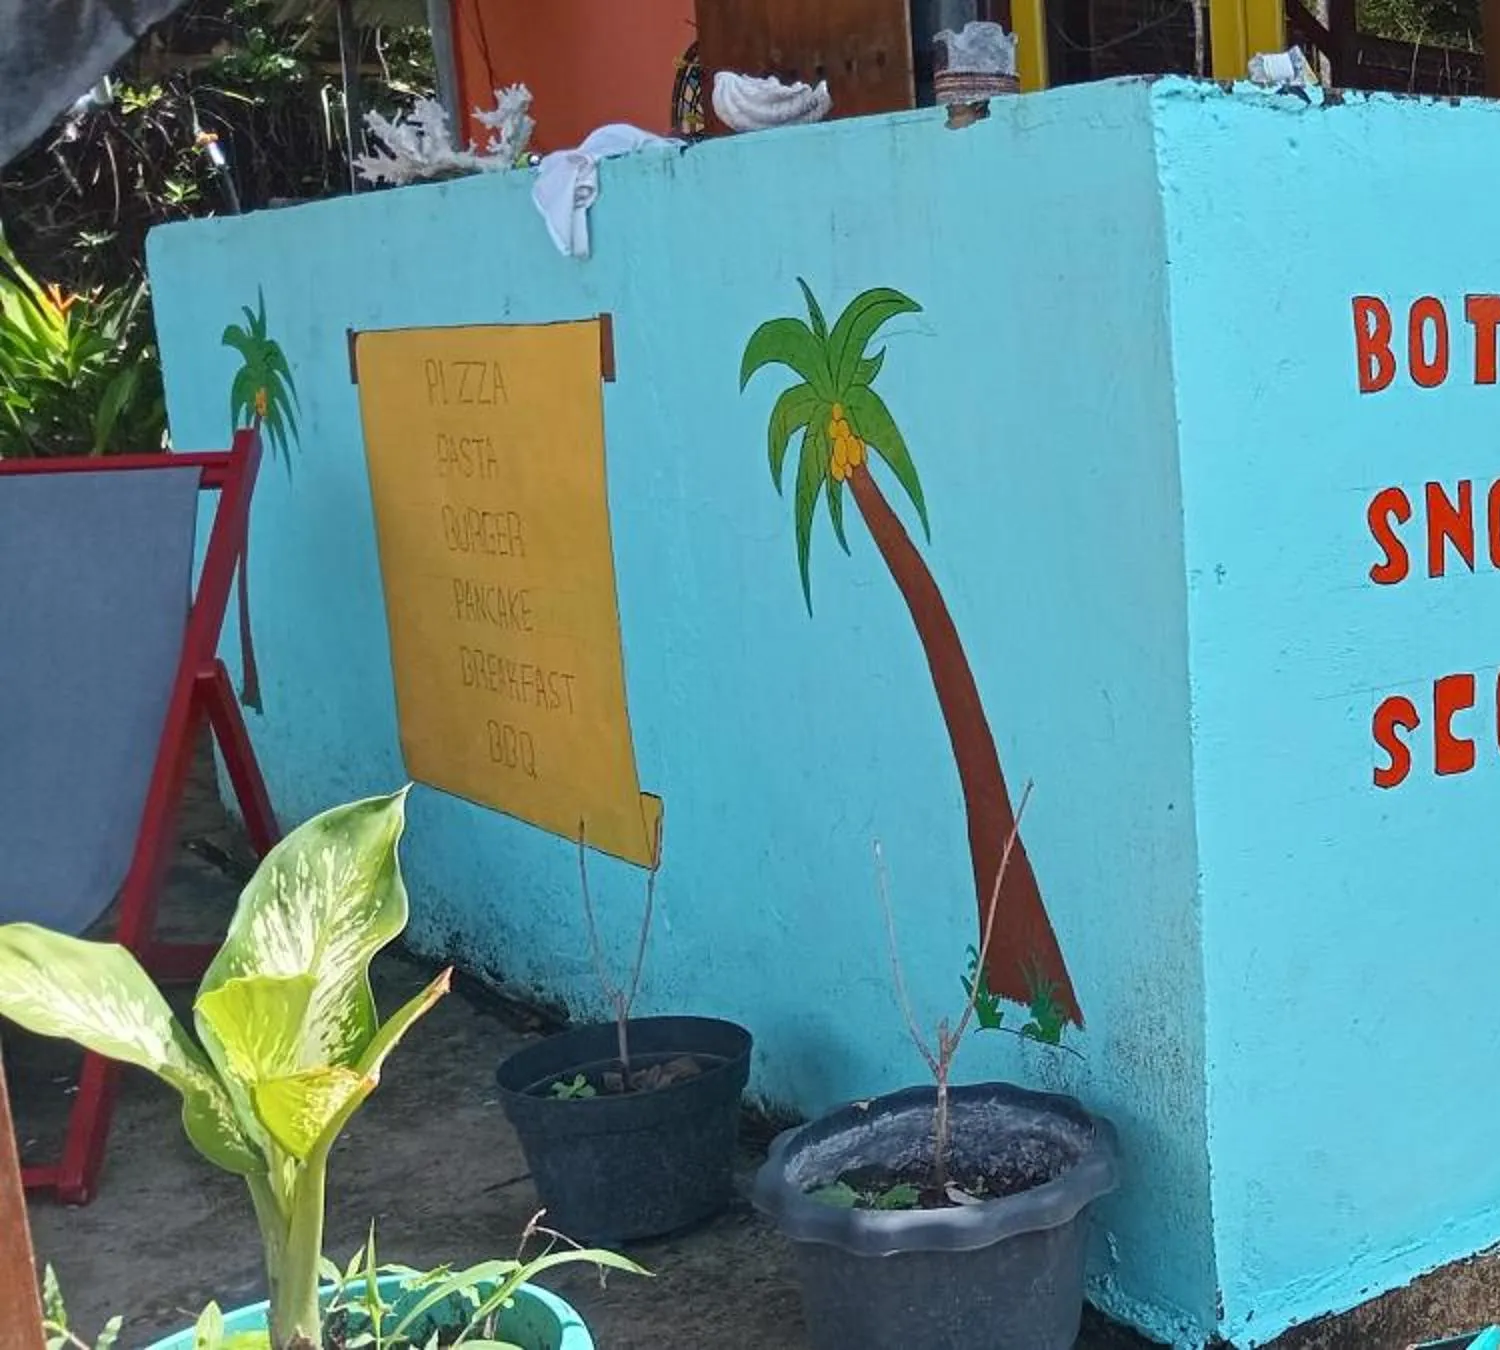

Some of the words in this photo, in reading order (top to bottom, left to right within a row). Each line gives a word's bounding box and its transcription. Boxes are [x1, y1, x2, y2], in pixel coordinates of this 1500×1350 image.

[424, 357, 509, 406] PIZZA
[436, 433, 499, 478] PASTA
[441, 503, 527, 558] BURGER
[452, 576, 534, 634] PANCAKE
[459, 645, 577, 716] BREAKFAST
[486, 718, 539, 781] BBQ
